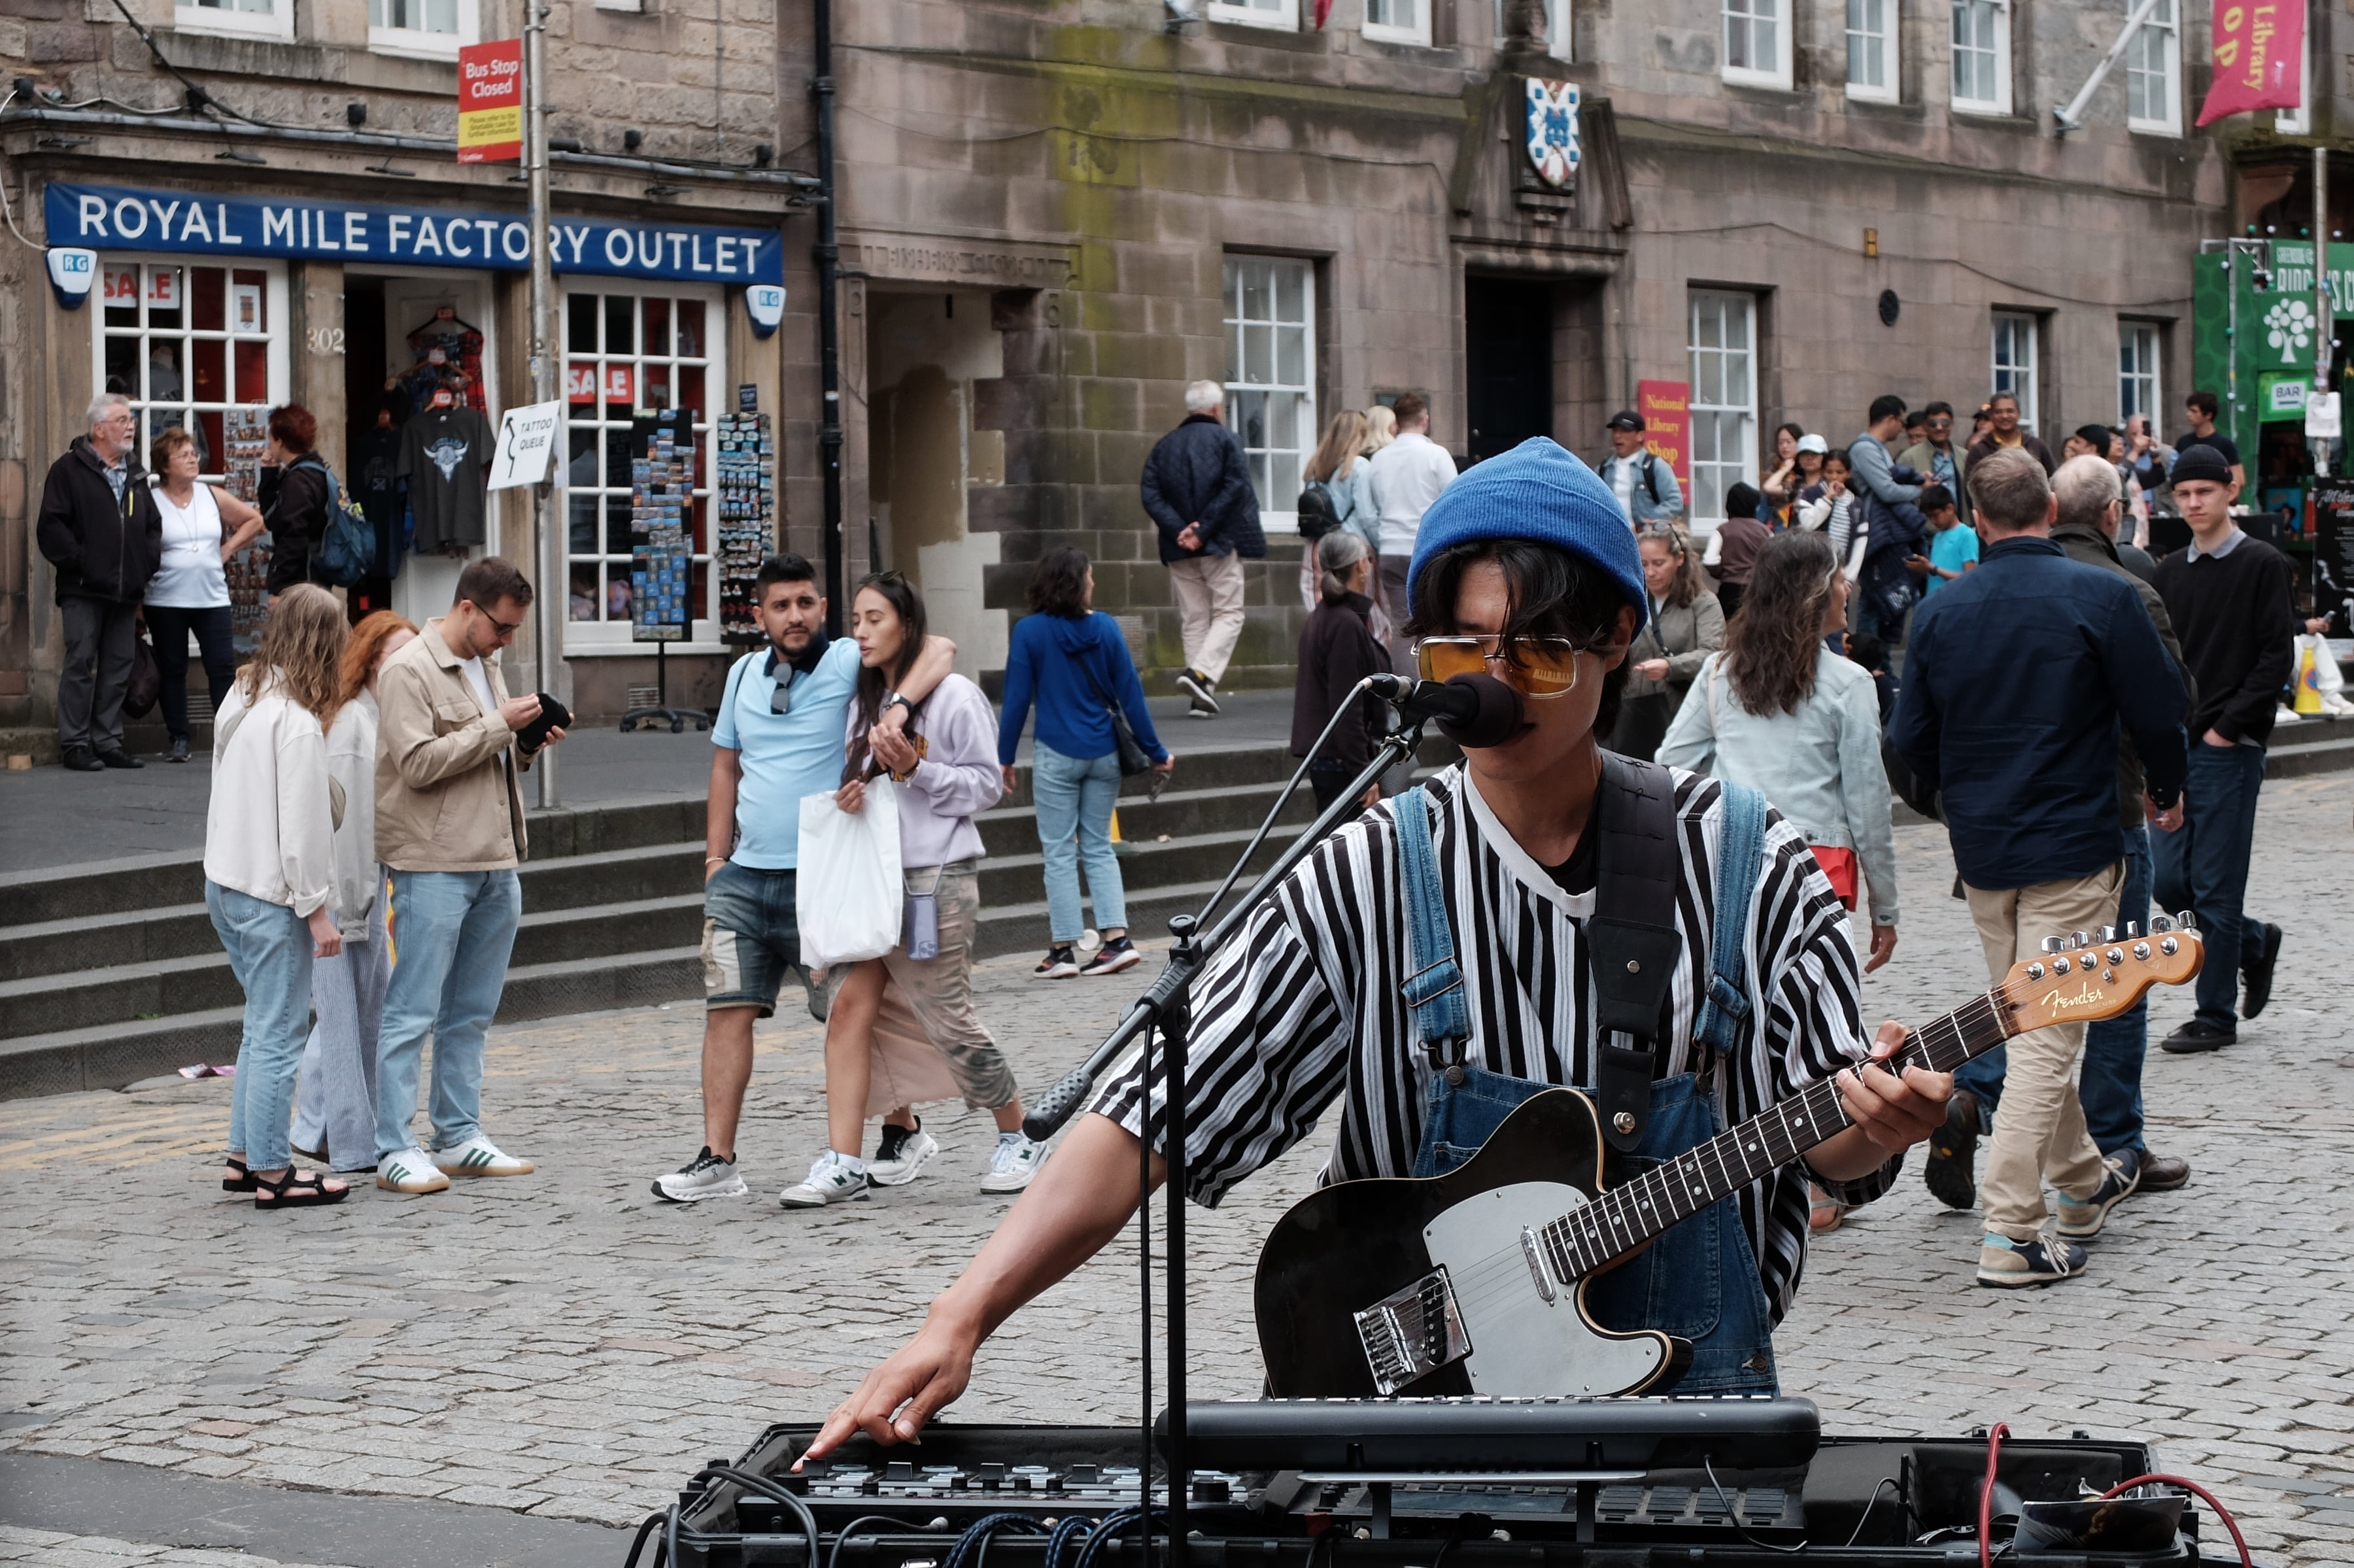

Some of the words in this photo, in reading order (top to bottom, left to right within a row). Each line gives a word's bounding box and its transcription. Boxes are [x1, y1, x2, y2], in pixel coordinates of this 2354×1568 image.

[2242, 4, 2276, 92] Library
[466, 63, 488, 79] Bus
[491, 59, 519, 77] Stop
[471, 78, 513, 98] Closed
[80, 195, 243, 245] ROYAL
[263, 206, 368, 251] MILE
[605, 228, 761, 275] OUTLET
[64, 255, 88, 271] RG
[105, 272, 171, 299] SAE
[760, 291, 779, 305] RG
[306, 328, 345, 352] 302
[568, 369, 626, 396] SAE
[2276, 386, 2300, 398] BAR
[1646, 394, 1685, 411] National
[521, 418, 553, 433] TATTOO
[1646, 417, 1680, 437] Library
[519, 435, 545, 451] QUEUE
[1647, 439, 1679, 467] Shop
[2041, 981, 2104, 1017] Fender
